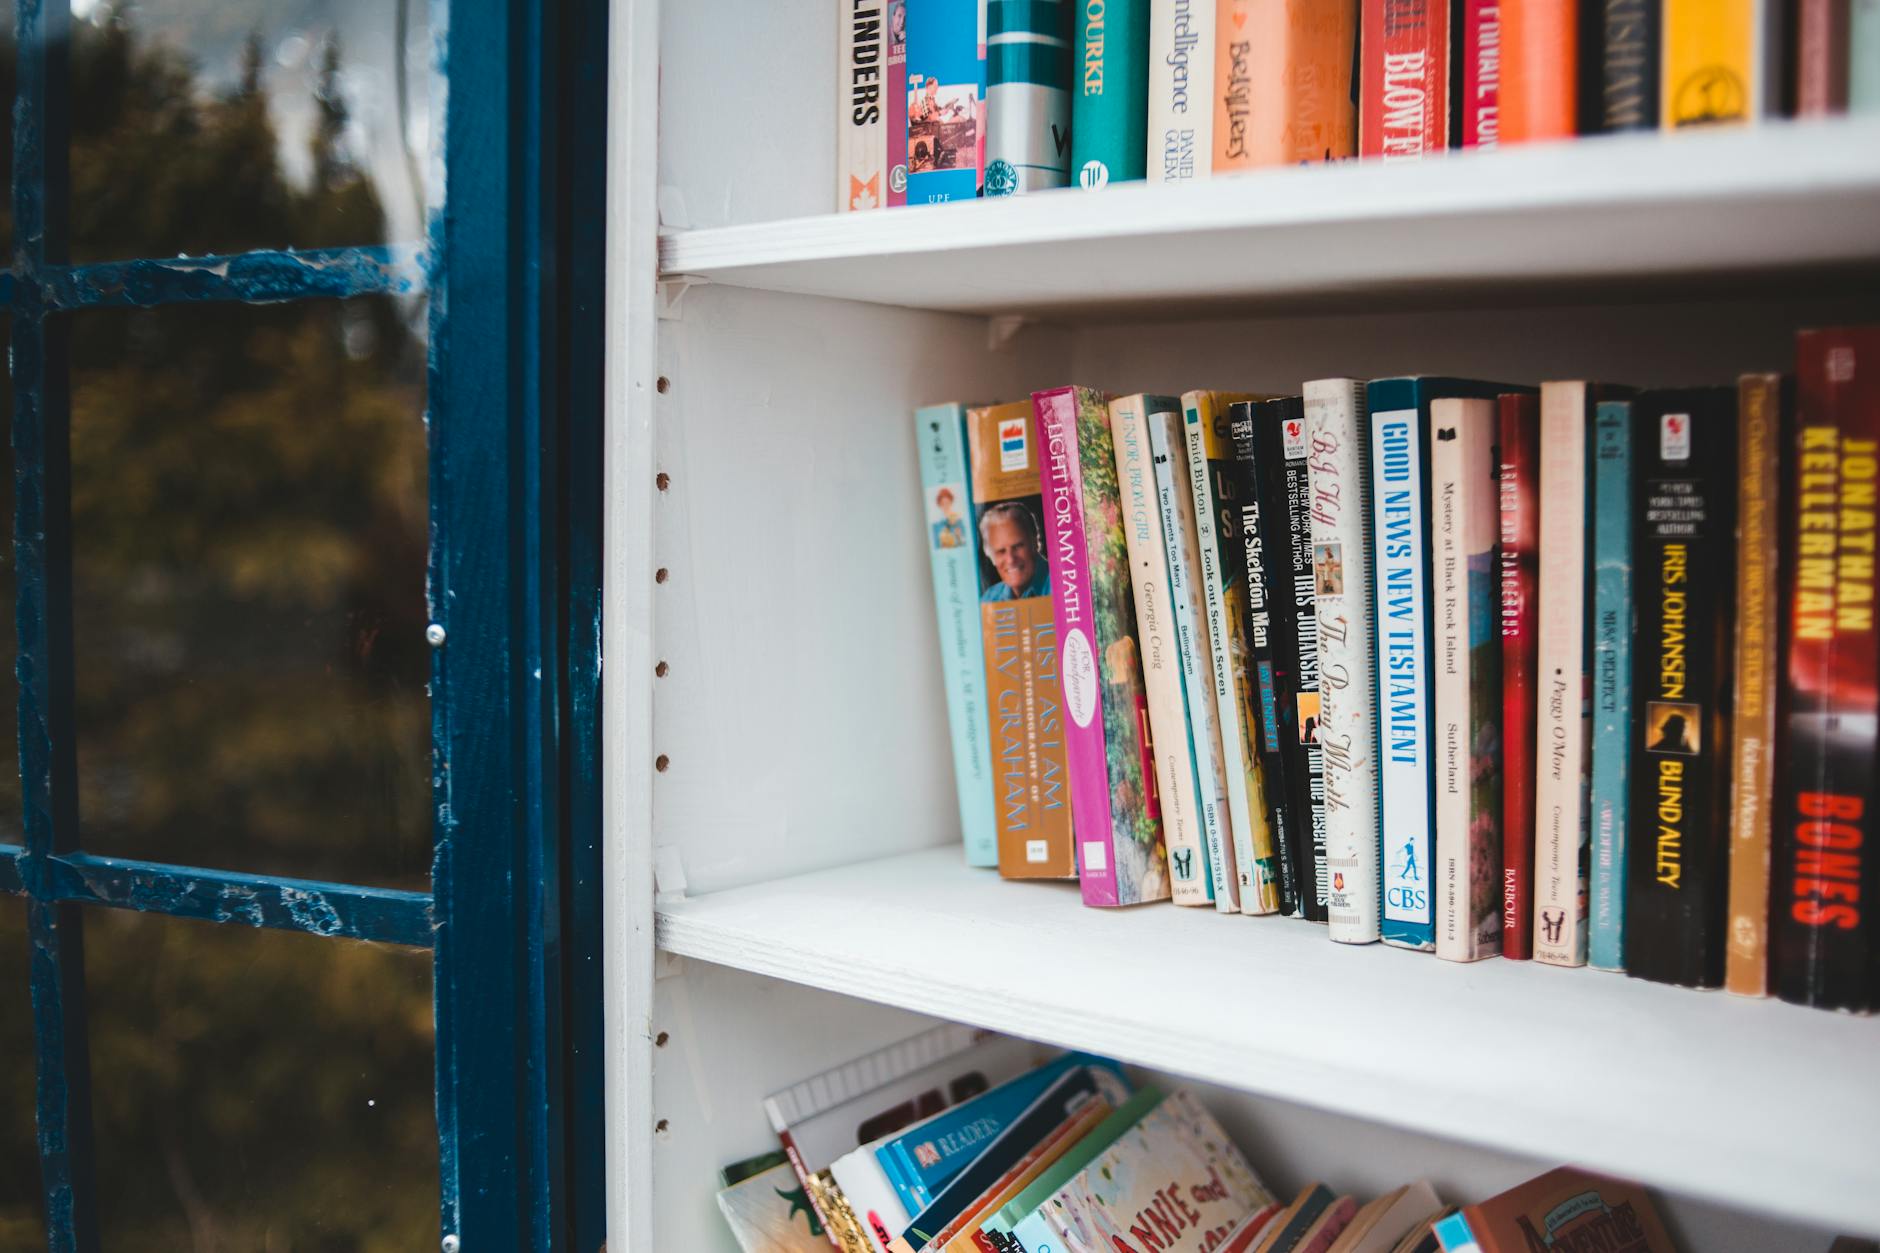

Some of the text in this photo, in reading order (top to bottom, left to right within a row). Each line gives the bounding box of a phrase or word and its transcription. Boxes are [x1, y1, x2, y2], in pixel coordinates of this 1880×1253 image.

[1383, 48, 1425, 130] BLOW
[1190, 432, 1200, 464] Enid
[1128, 467, 1144, 508] PROM
[1161, 487, 1171, 505] Two
[1191, 469, 1207, 515] Blyton
[1299, 486, 1310, 506] NEW
[1311, 480, 1341, 527] Hoff
[1441, 483, 1456, 534] Mystery
[1048, 423, 1080, 623] LIGHT FOR MY PATH
[1165, 509, 1176, 542] Parents
[1286, 470, 1302, 571] BESTSELLING AUTHOR
[1300, 508, 1311, 533] YORK
[1795, 427, 1839, 639] KELLERMAN
[1837, 438, 1877, 630] JONATHAN
[1169, 545, 1179, 561] Too
[1203, 547, 1213, 580] Look
[1302, 536, 1312, 564] TIMES
[1445, 539, 1454, 550] at
[1171, 564, 1182, 588] Many
[1209, 585, 1218, 607] out
[1241, 501, 1269, 648] The Skeleton Man
[1293, 574, 1315, 606] IRIS
[1382, 422, 1417, 767] GOOD NEWS NEW TESTAMENT
[1445, 557, 1456, 591] Black
[1143, 582, 1159, 632] Georgia
[1446, 598, 1457, 629] Rock
[1661, 544, 1687, 699] IRIS JOHANSEN
[1148, 635, 1164, 670] Craig
[1181, 625, 1194, 675] Bellingham
[1211, 610, 1222, 653] Secret
[1446, 635, 1457, 674] Island
[1034, 624, 1057, 689] JUST
[1068, 636, 1087, 719] Grandparents
[1081, 650, 1092, 672] FOR
[1215, 655, 1226, 696] Seven
[994, 608, 1028, 832] BILLY GRAHAM
[1022, 628, 1039, 803] THE AUTOBIOGRAPHY OF
[1039, 697, 1059, 734] AS
[1259, 665, 1278, 749] JAY BENNETT
[1318, 611, 1352, 813] The Penny Whistle
[1501, 464, 1519, 929] ARMED AND DANGEROUS BARBOUR
[1551, 680, 1566, 722] Peggy
[1447, 723, 1458, 793] Sutherland
[1552, 726, 1565, 780] O'More
[1740, 738, 1759, 789] Robert
[1042, 757, 1064, 811] AM
[1206, 803, 1215, 826] ISBN
[1657, 760, 1683, 888] BLIND ALLEY
[1739, 793, 1757, 838] Moss
[1550, 805, 1562, 872] Contemporary
[1791, 791, 1863, 930] BONES
[1388, 887, 1426, 910] CBS
[1112, 1182, 1200, 1253] ANNIE
